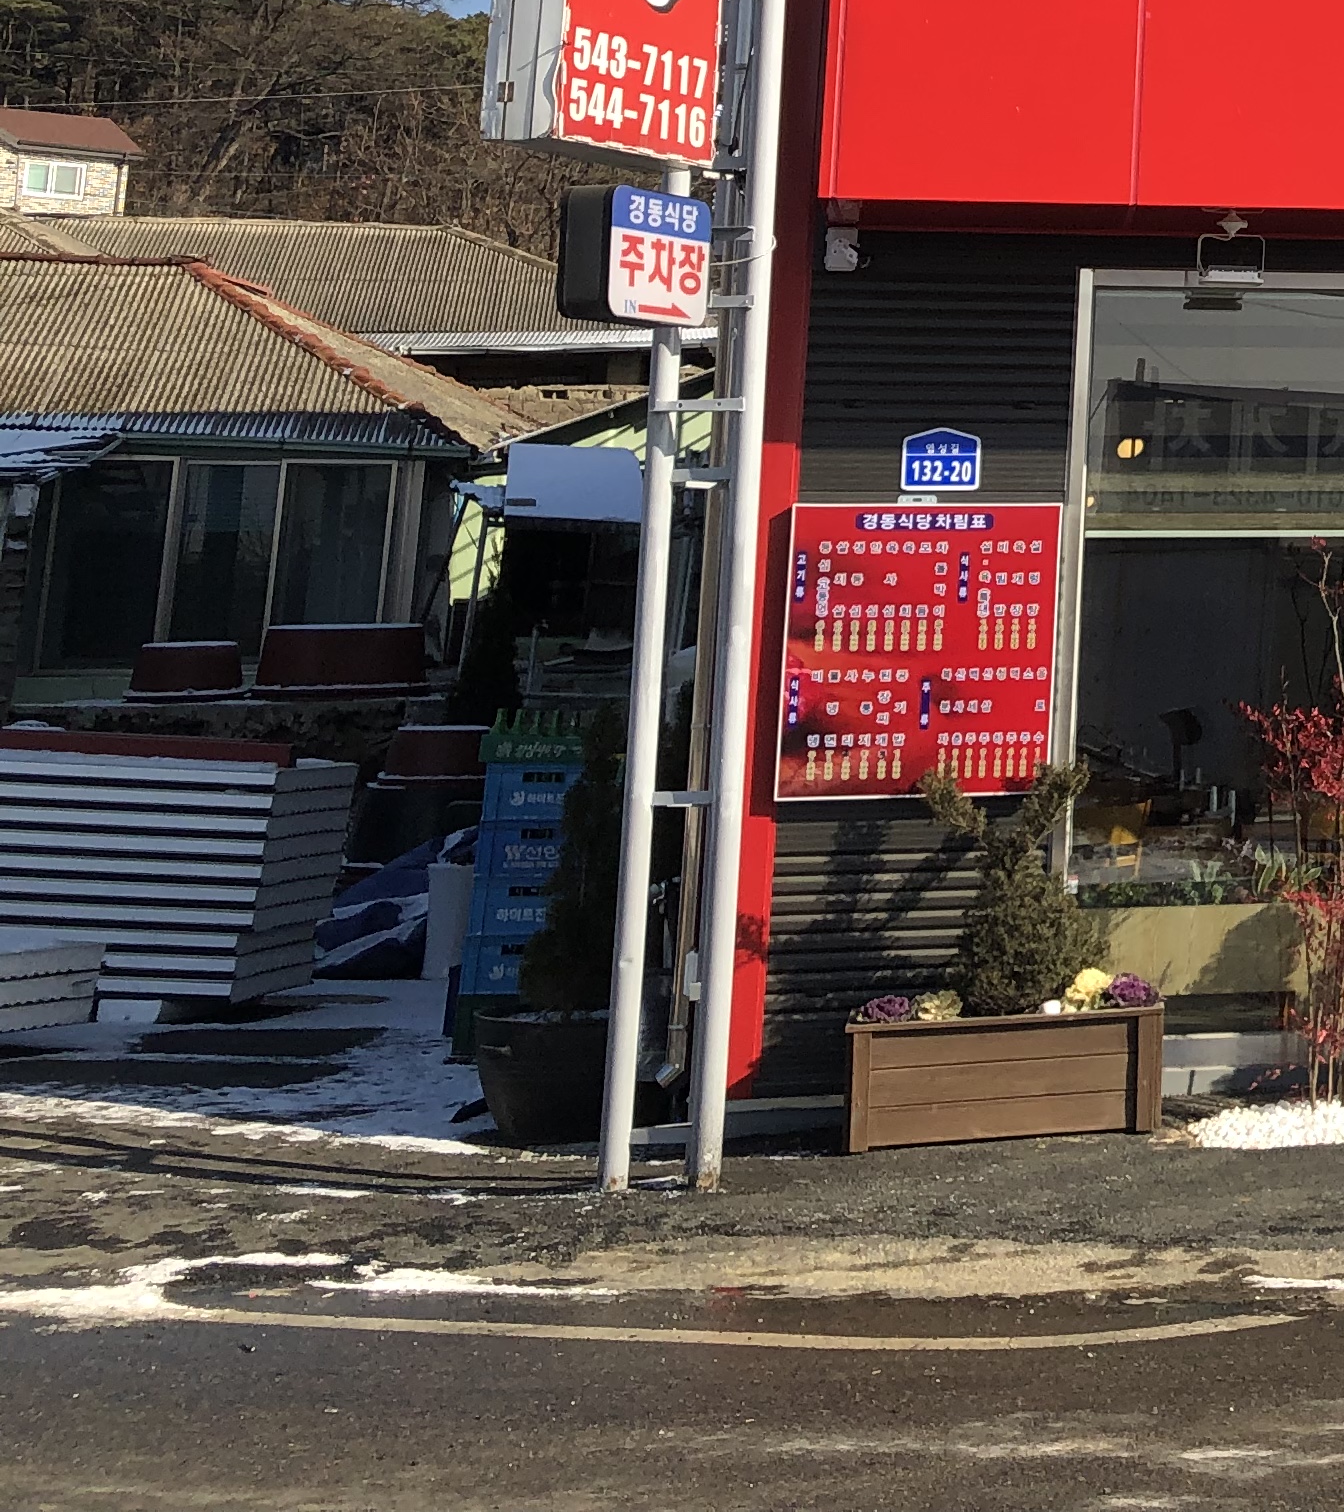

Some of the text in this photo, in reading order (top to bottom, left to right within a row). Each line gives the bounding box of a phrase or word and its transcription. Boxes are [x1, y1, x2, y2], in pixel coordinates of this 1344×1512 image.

[572, 24, 710, 100] 543-7117
[567, 74, 707, 149] 544-7116
[629, 194, 698, 233] 경동식당
[620, 234, 705, 295] 주차장
[624, 300, 637, 314] IN
[911, 460, 971, 482] 132-20
[862, 513, 987, 530] 경동식당 차림표
